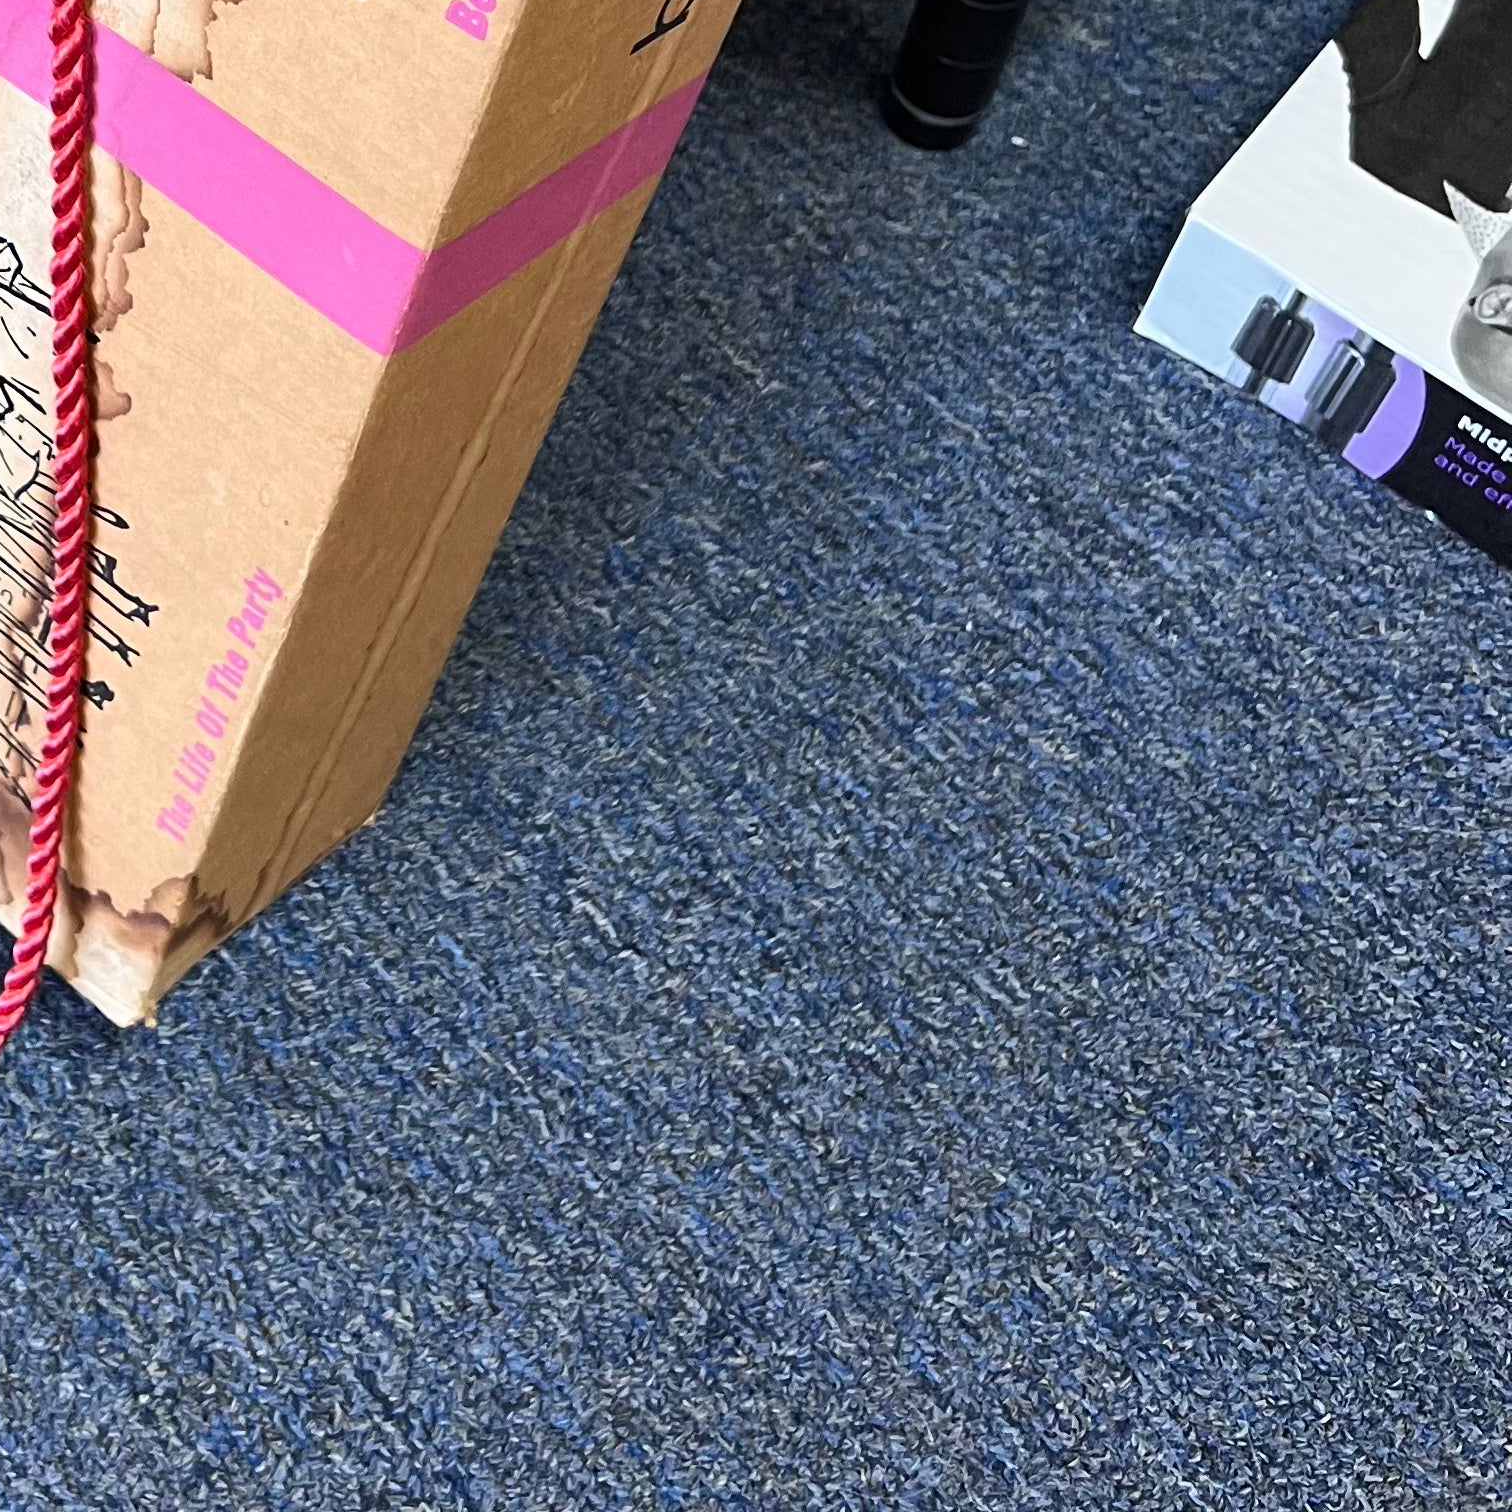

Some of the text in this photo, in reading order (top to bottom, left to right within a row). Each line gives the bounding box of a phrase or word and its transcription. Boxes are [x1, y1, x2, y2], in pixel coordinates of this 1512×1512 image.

[1434, 454, 1479, 488] and
[1444, 436, 1508, 485] Made
[156, 566, 283, 843] The Life Of The Party
